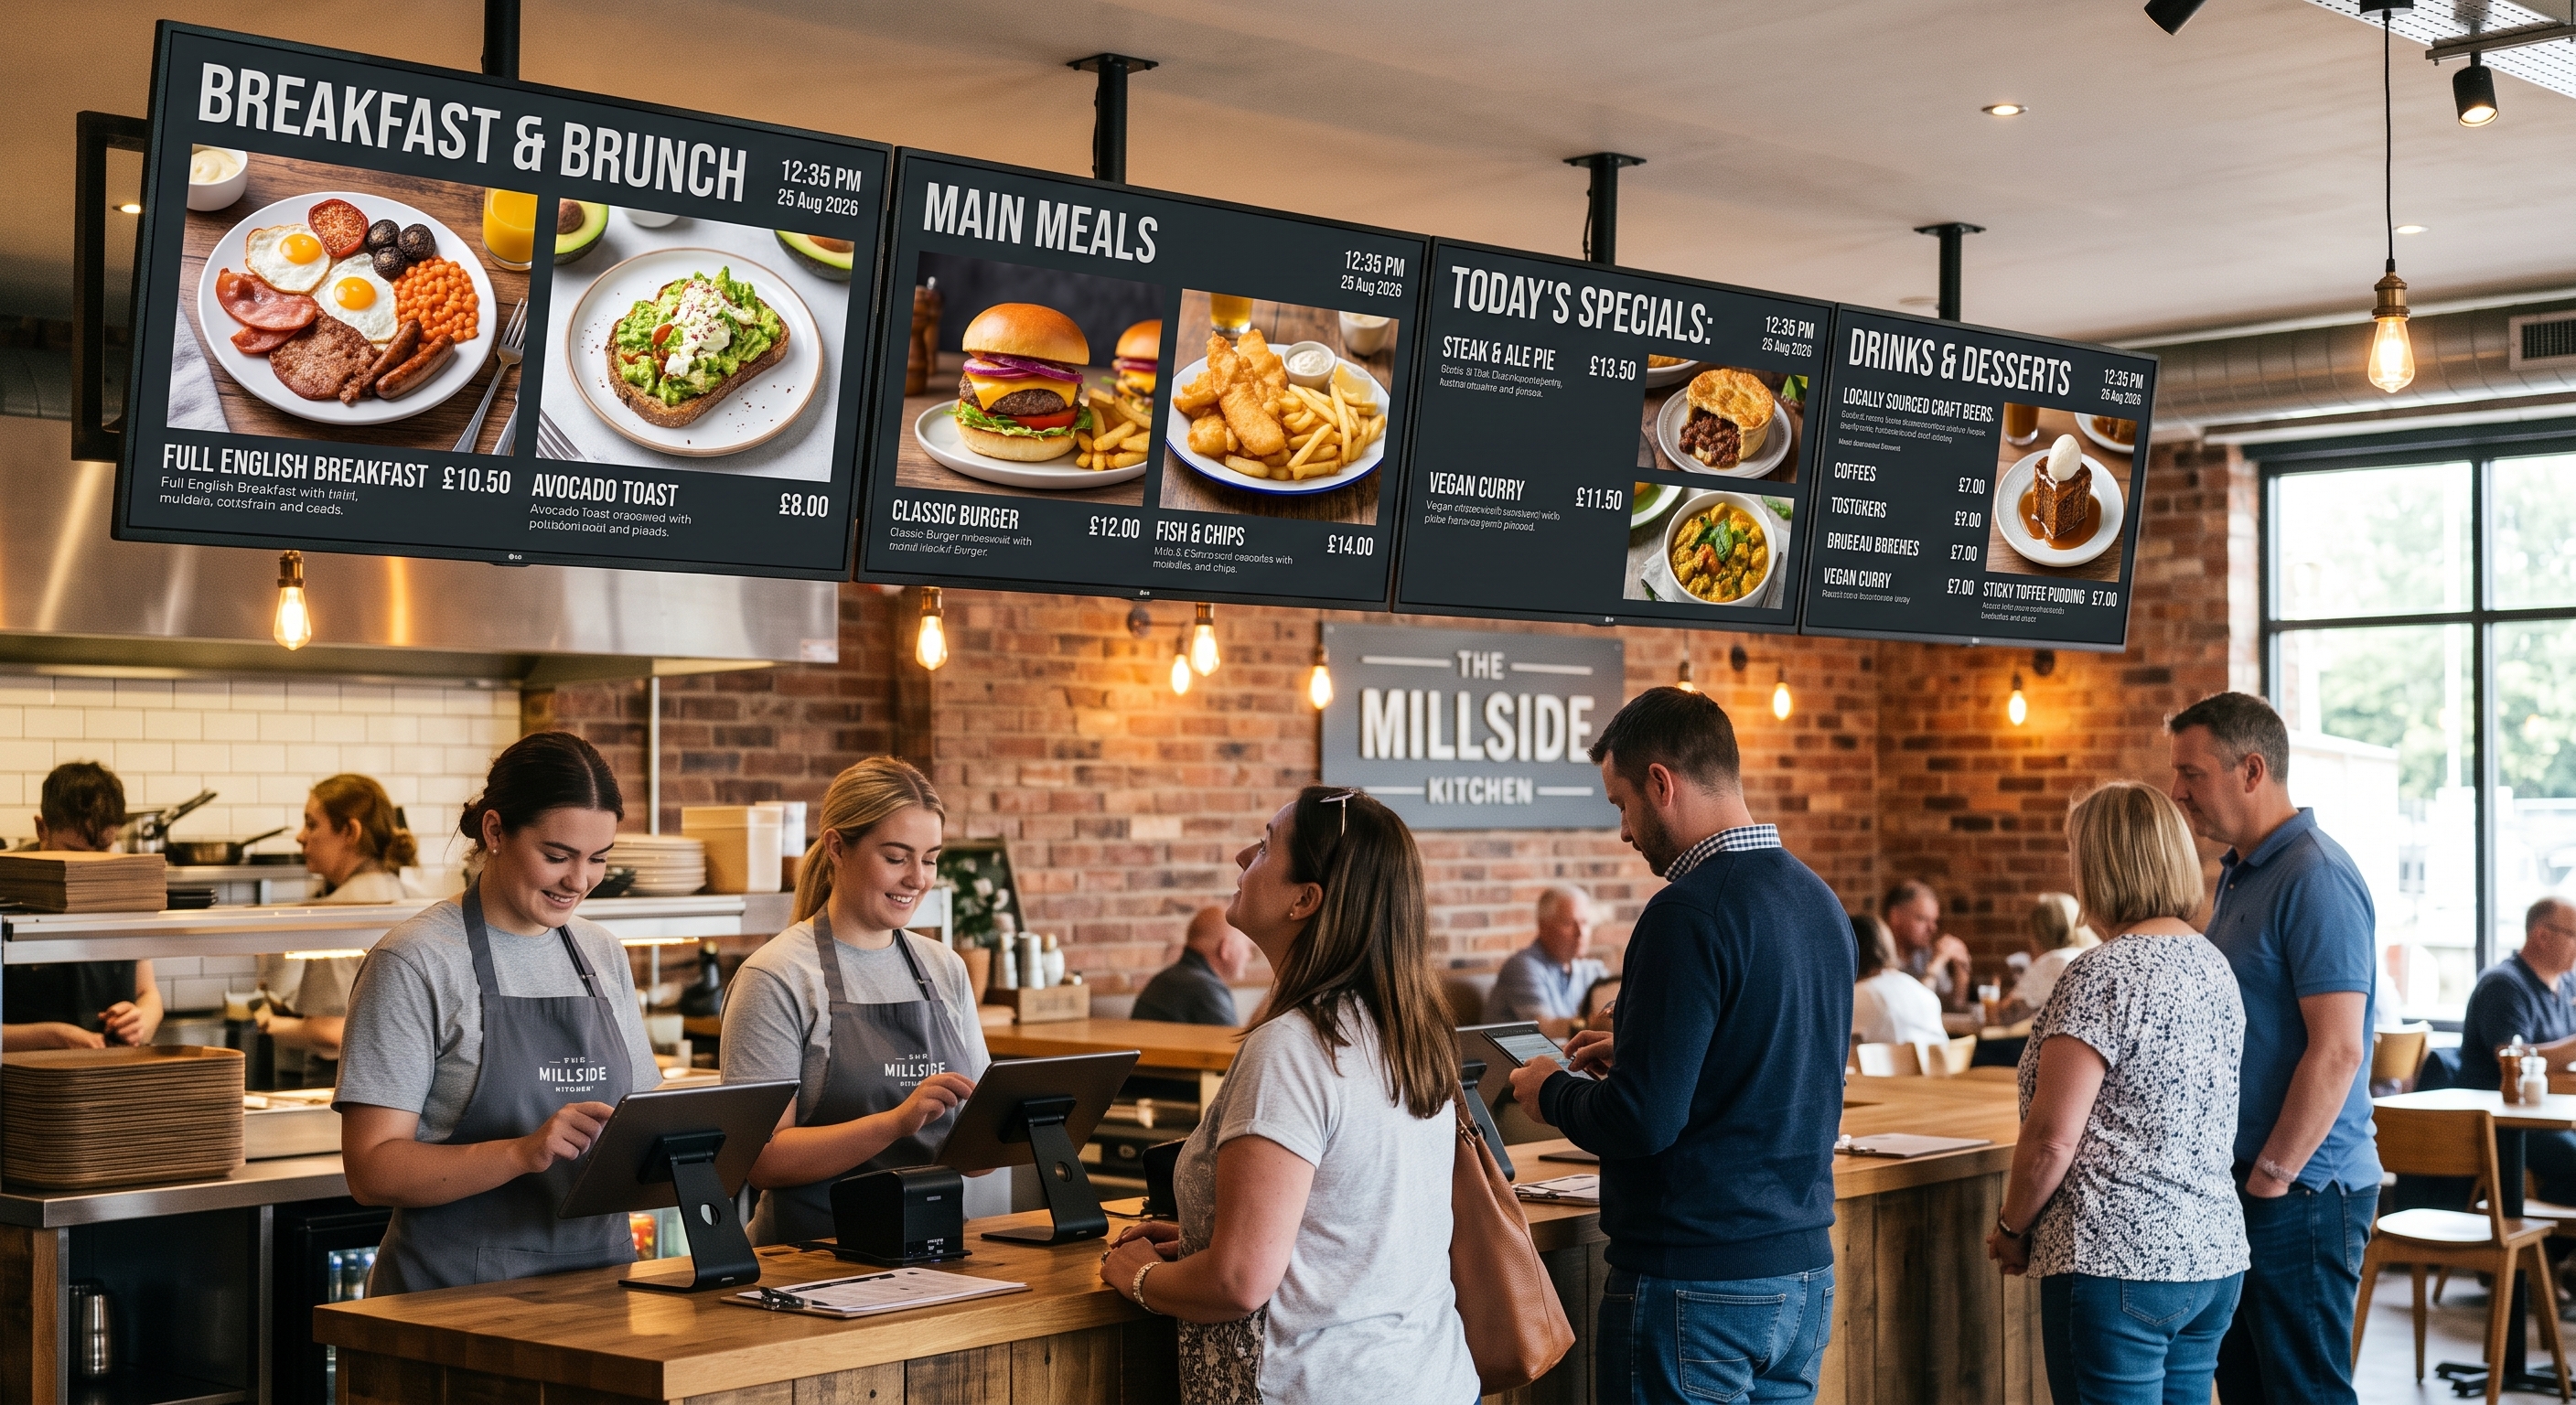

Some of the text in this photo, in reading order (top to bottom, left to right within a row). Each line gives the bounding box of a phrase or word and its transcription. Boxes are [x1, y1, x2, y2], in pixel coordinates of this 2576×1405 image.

[199, 62, 746, 202] BREAKFAST & BRUNCH
[782, 160, 861, 192] 12:35 PM
[778, 188, 858, 216] 25 Aug 2026
[924, 182, 1157, 263] MAIN MEALS
[1346, 251, 1404, 277] 12:35 PM
[1341, 275, 1401, 297] 25 Aug 2026
[1452, 266, 1712, 344] TODAY'S SPECIALS:
[1766, 316, 1814, 339] 12:35 PM
[1444, 336, 1555, 370] STEAK & ALE PIE
[1775, 339, 1789, 356] Aug
[1792, 343, 1811, 357] 2026
[1589, 356, 1636, 381] £13.50
[1849, 328, 2071, 395] DRINKS & DESSERTS
[1499, 385, 1514, 394] and
[2105, 370, 2143, 389] 12:35 PM
[1843, 388, 1884, 408] LOCALLY
[1886, 393, 1929, 413] SOURCED
[1932, 400, 1961, 418] CRAFT
[2124, 392, 2141, 405] 2026
[163, 444, 428, 488] FULL ENGLISH BREAKFAST
[1835, 462, 1876, 481] COFFEES
[162, 477, 183, 488] Full
[188, 478, 233, 493] English
[238, 482, 295, 496] Breakfast
[299, 487, 326, 499] with
[443, 467, 510, 493] £10.50
[531, 474, 679, 506] AVOCADO TOAST
[1431, 472, 1525, 500] VEGAN CURRY
[1959, 477, 1985, 494] £7.00
[280, 502, 303, 511] and
[779, 493, 828, 517] £8.00
[1427, 500, 1452, 512] Vegan
[1576, 488, 1622, 510] £11.50
[531, 504, 579, 516] Avocado
[583, 508, 609, 519] Toast
[670, 514, 691, 524] with
[893, 499, 1018, 529] CLASSIC BURGER
[609, 525, 629, 533] and
[891, 528, 923, 538] Classic
[927, 530, 959, 542] Burger
[1014, 537, 1032, 545] with
[1089, 516, 1140, 538] £12.00
[1156, 521, 1244, 546] FISH & CHIPS
[1327, 535, 1373, 555] £14.00
[1950, 544, 1977, 561] £7.00
[1276, 555, 1293, 564] with
[1825, 568, 1892, 588] VEGAN CURRY
[1948, 579, 1974, 595] £7.00
[1983, 582, 2085, 604] STICKY TOFFEE PUDDING
[2092, 591, 2117, 606] £7.00
[1457, 650, 1505, 680] THE
[1361, 689, 1595, 762] MILLSIDE
[1429, 777, 1533, 805] KITCHEN
[540, 1067, 606, 1082] MILLSIDE
